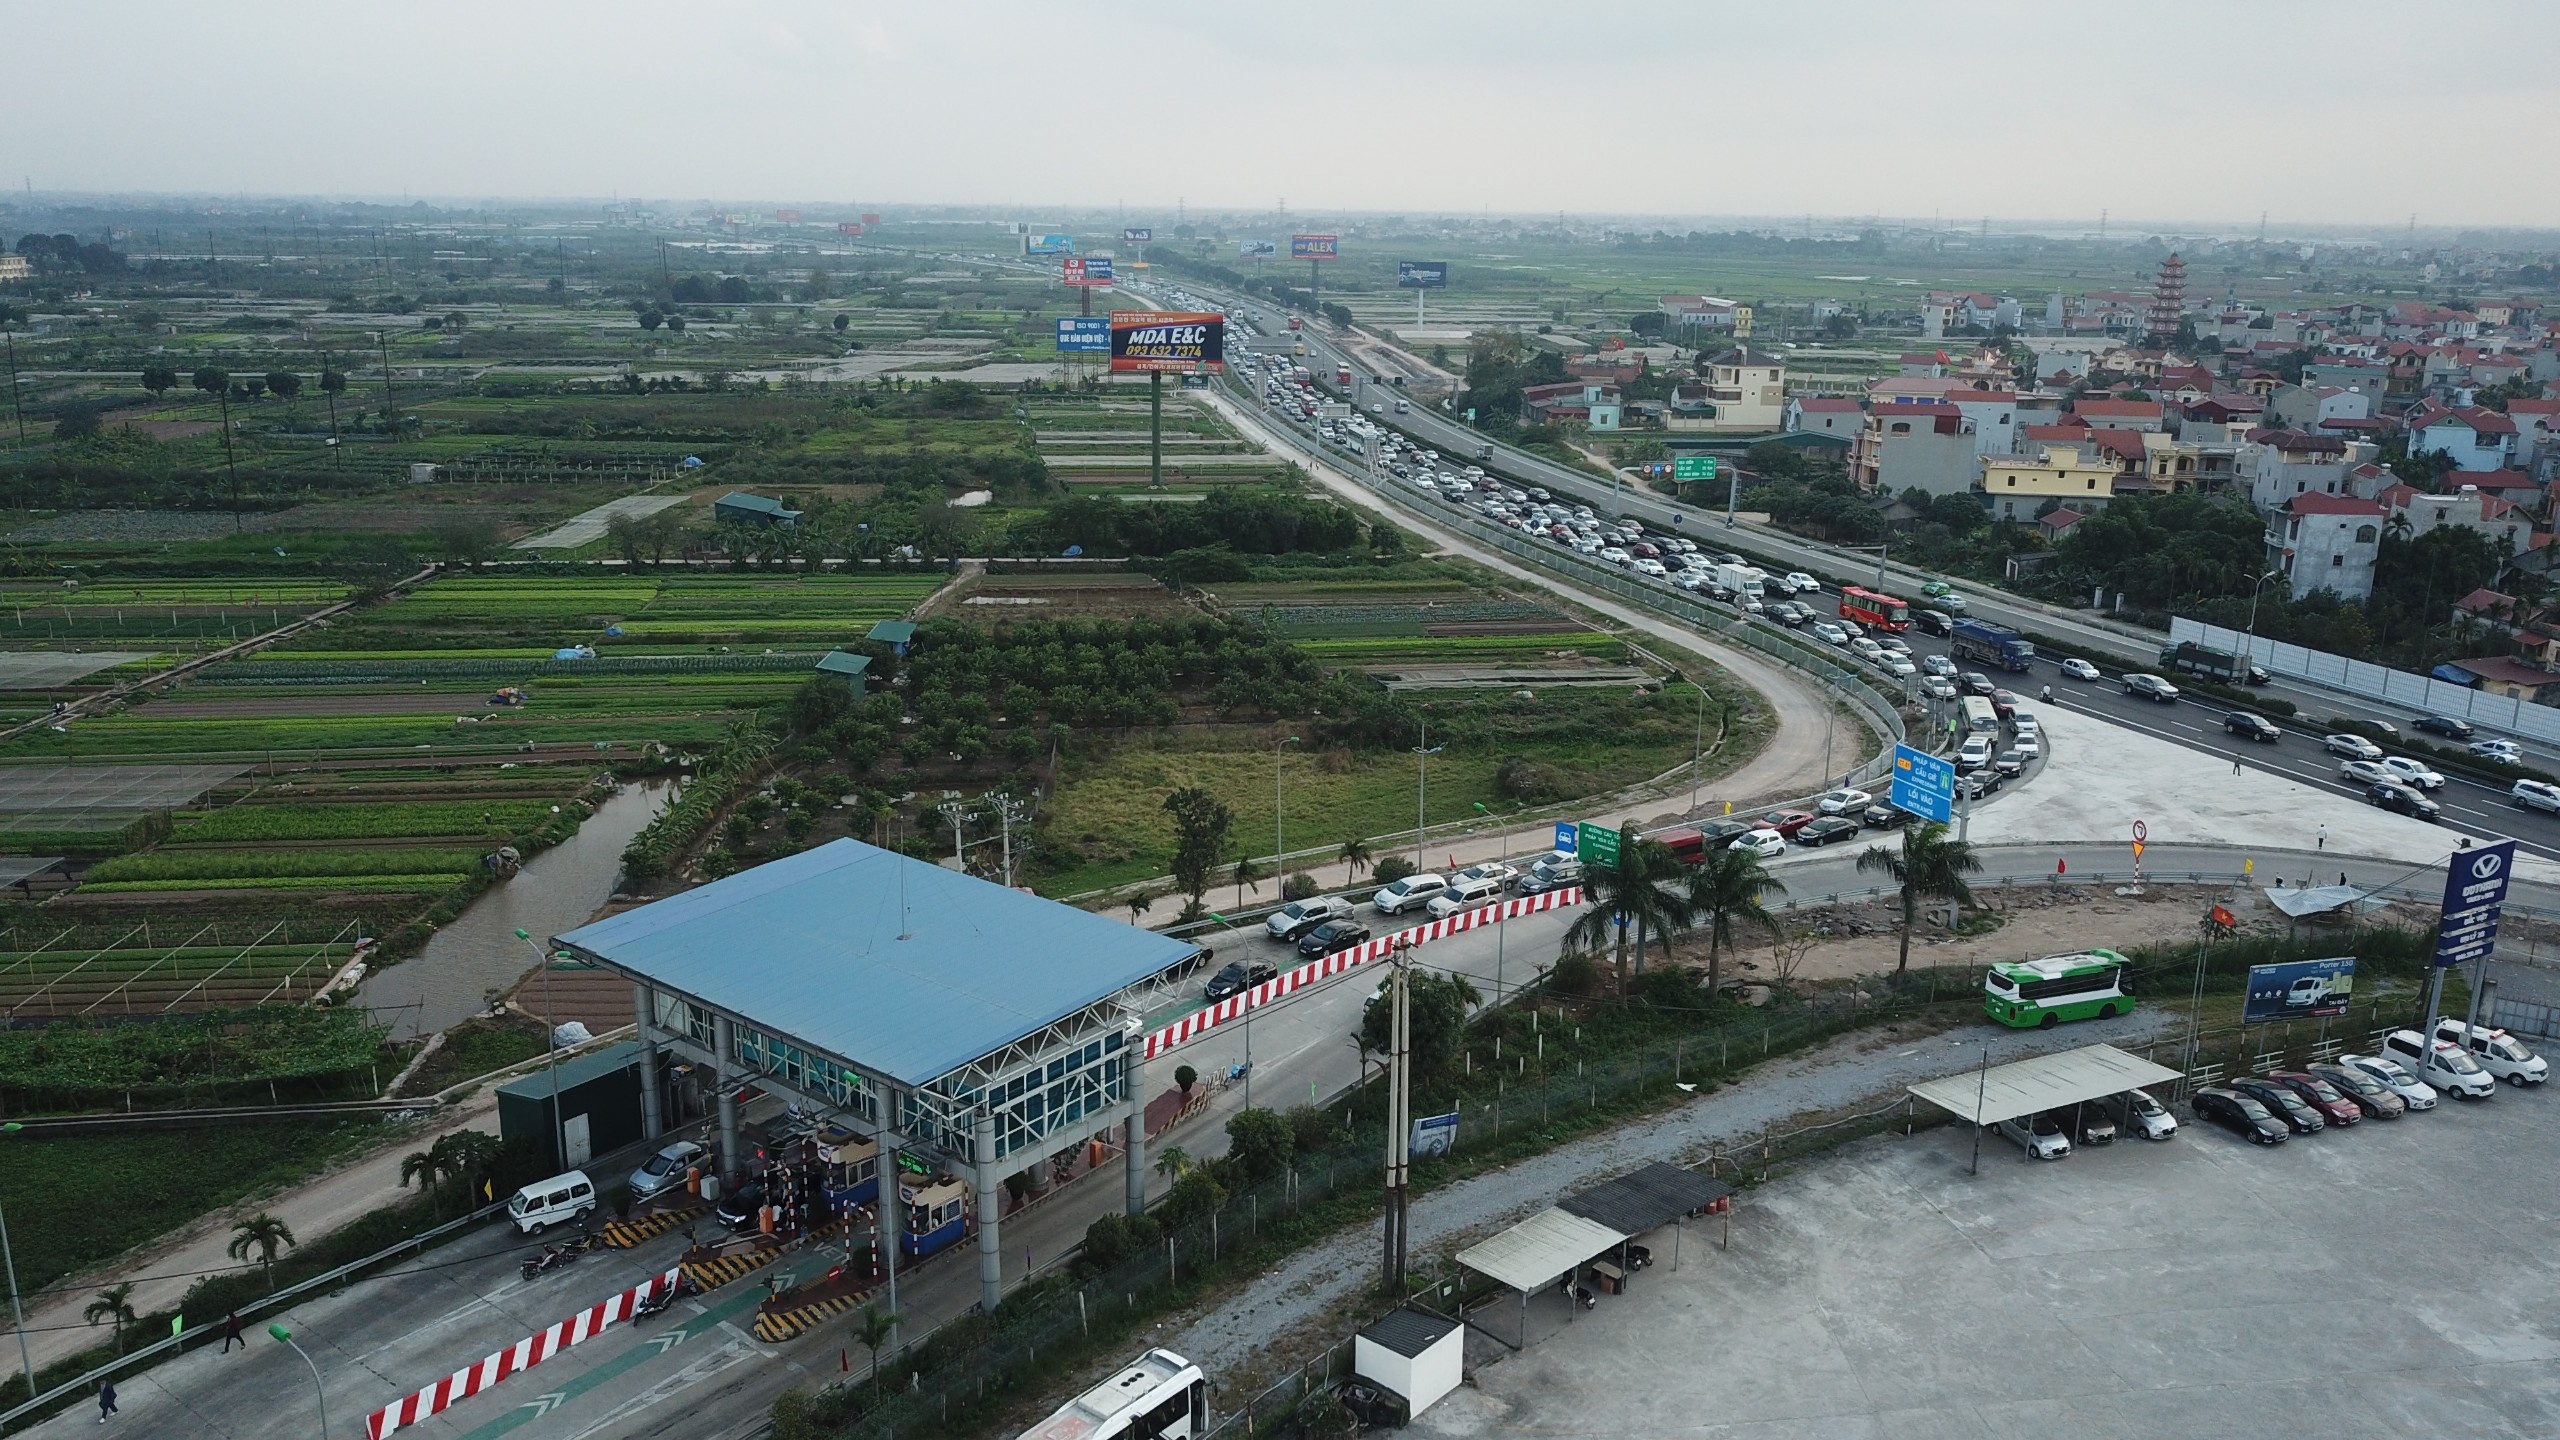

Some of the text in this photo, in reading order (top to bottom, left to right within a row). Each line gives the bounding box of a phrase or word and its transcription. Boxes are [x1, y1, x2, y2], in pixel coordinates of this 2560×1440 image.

[1307, 242, 1333, 252] ALEX
[1128, 326, 1206, 344] MDA E&C
[1125, 345, 1202, 357] 093 632 7374
[1913, 756, 1927, 766] PHÁP
[1908, 788, 1933, 805] LỐI VÀO
[1907, 801, 1934, 816] ENTRANCE
[2340, 959, 2354, 967] 150
